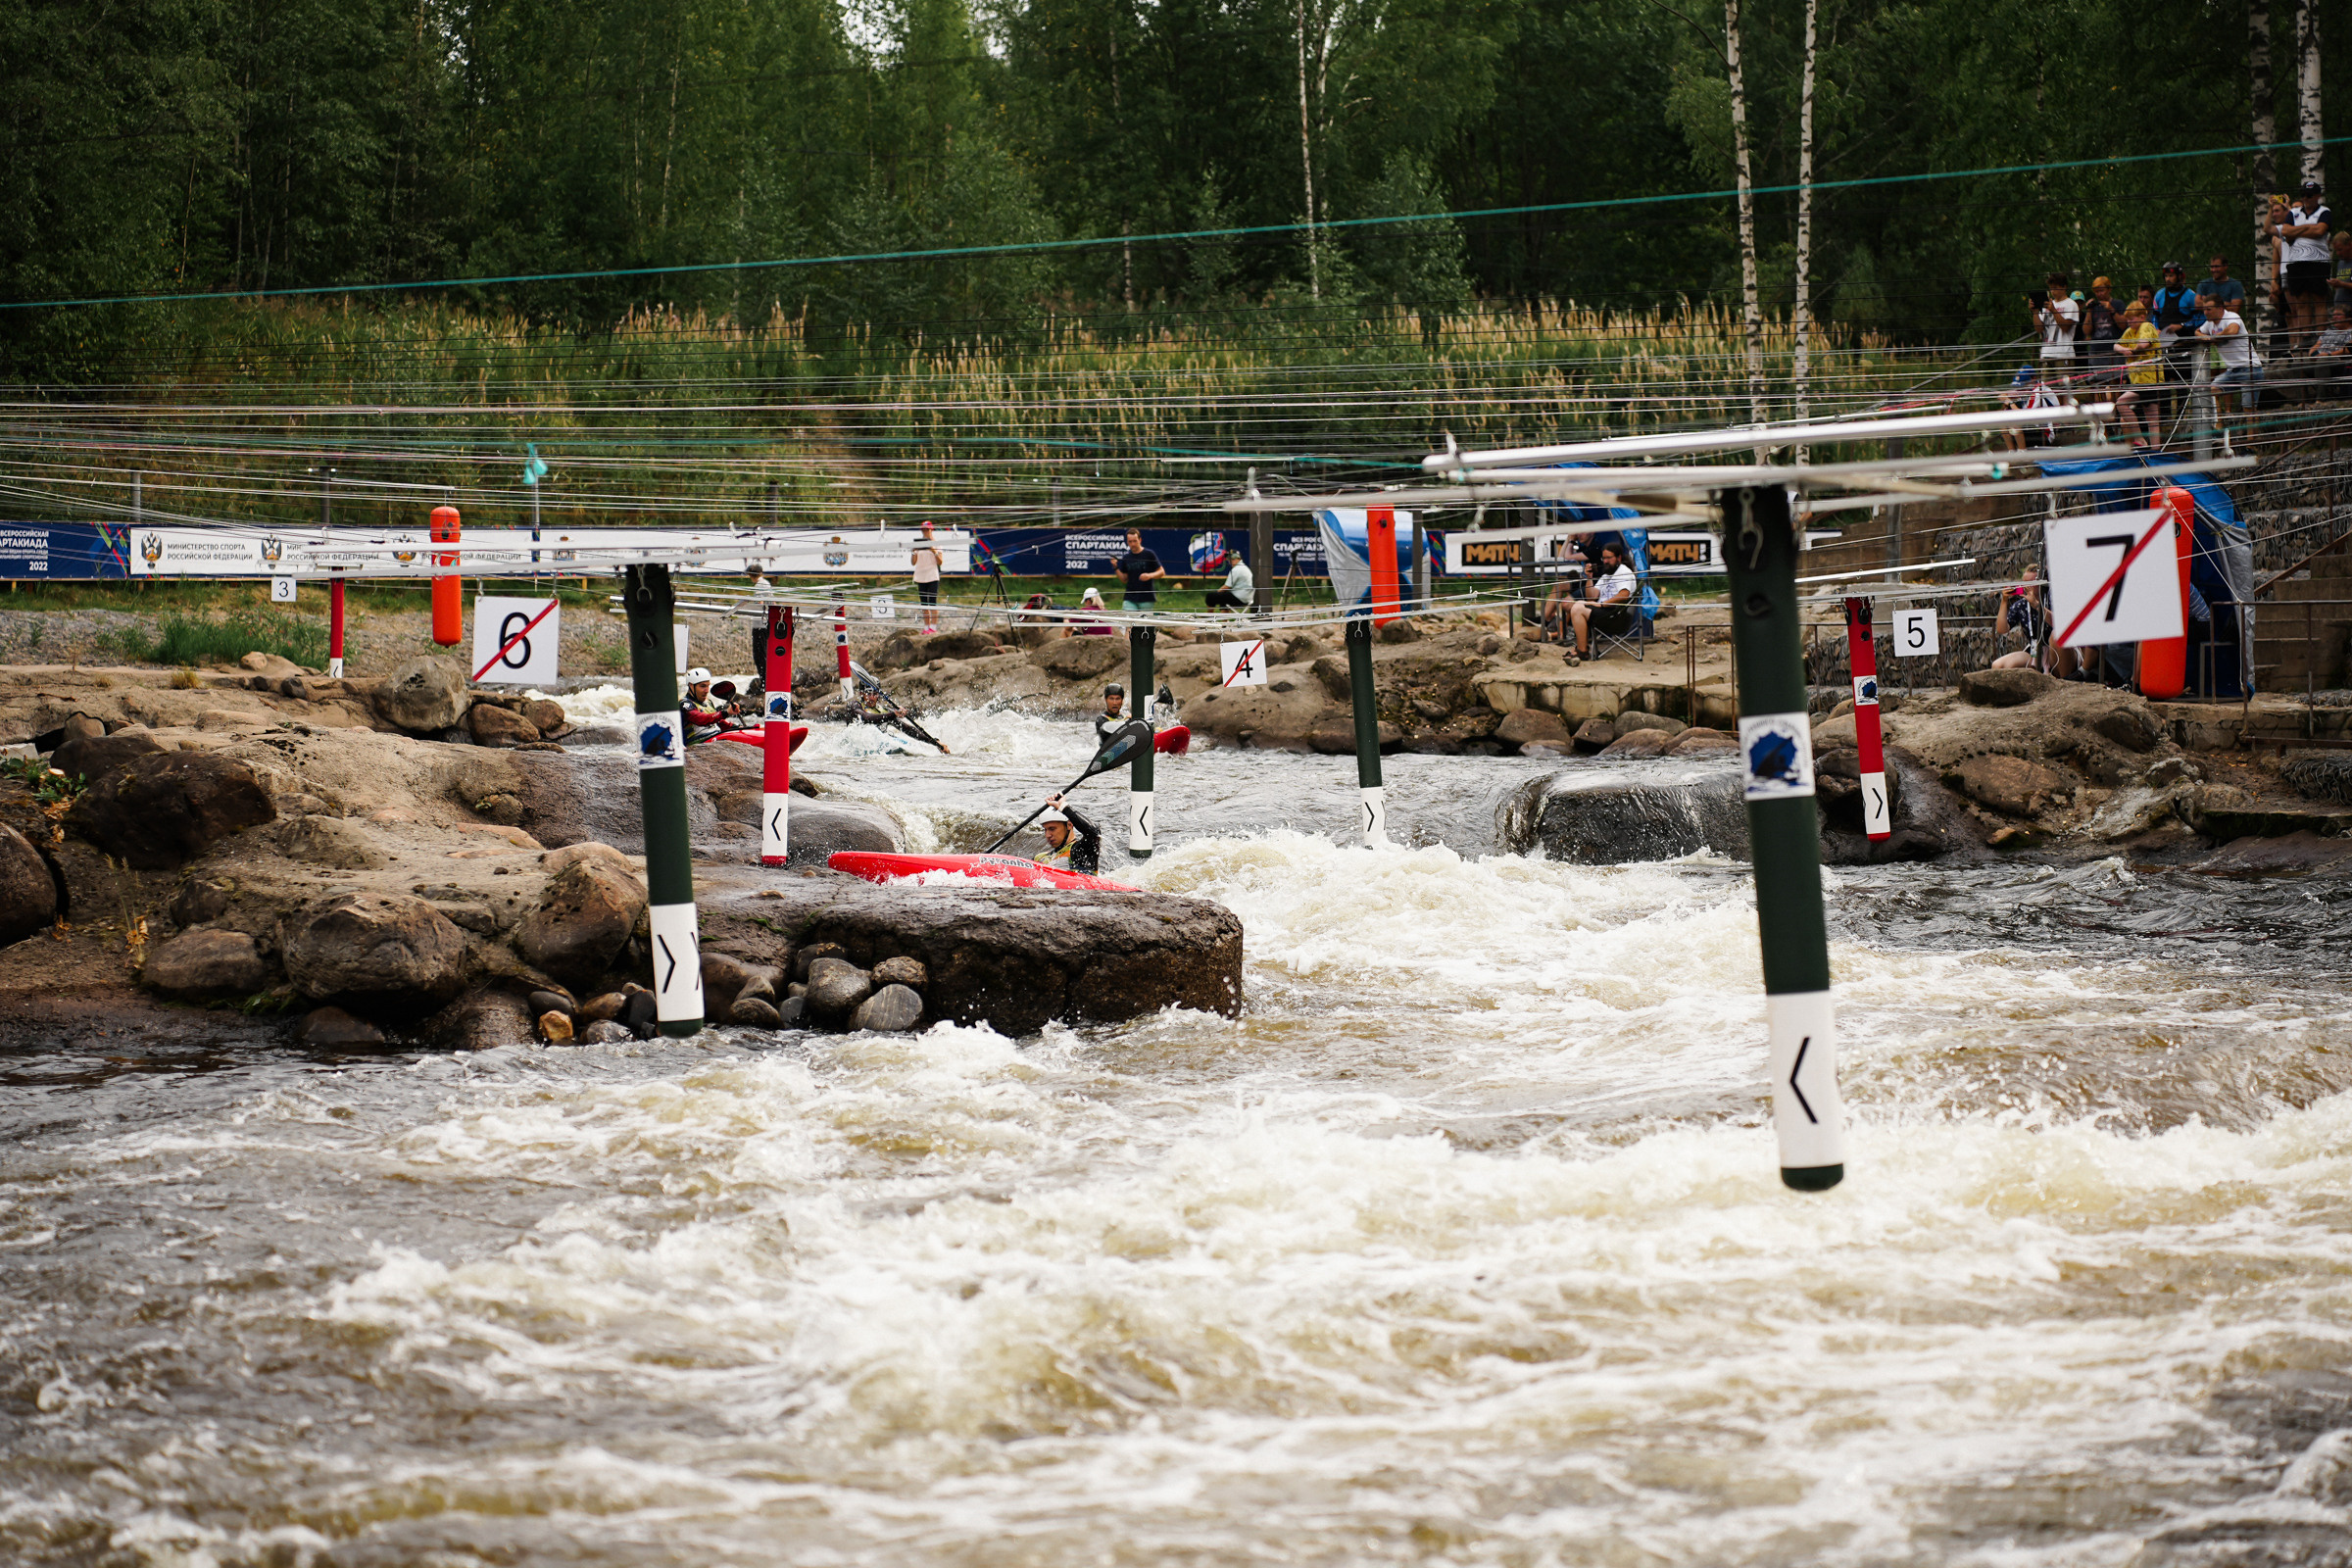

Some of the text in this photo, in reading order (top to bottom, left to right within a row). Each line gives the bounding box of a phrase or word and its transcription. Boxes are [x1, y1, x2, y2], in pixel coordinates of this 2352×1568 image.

[0, 529, 49, 538] ВСЕРОССИЙСКАЯ
[1064, 541, 1131, 551] СПАРТАКИА
[1465, 543, 1523, 563] МАТЧ
[167, 552, 253, 562] РОССИЙСКОЙ ФЕДЕРАЦИИ
[475, 553, 521, 562] ФЕДЕРАЦИИ
[29, 561, 48, 571] 2022
[1065, 560, 1089, 569] 2022
[2084, 533, 2135, 623] 7
[278, 580, 289, 598] 3
[1907, 615, 1926, 649] 5
[498, 611, 532, 670] 6
[1235, 648, 1253, 678] 4
